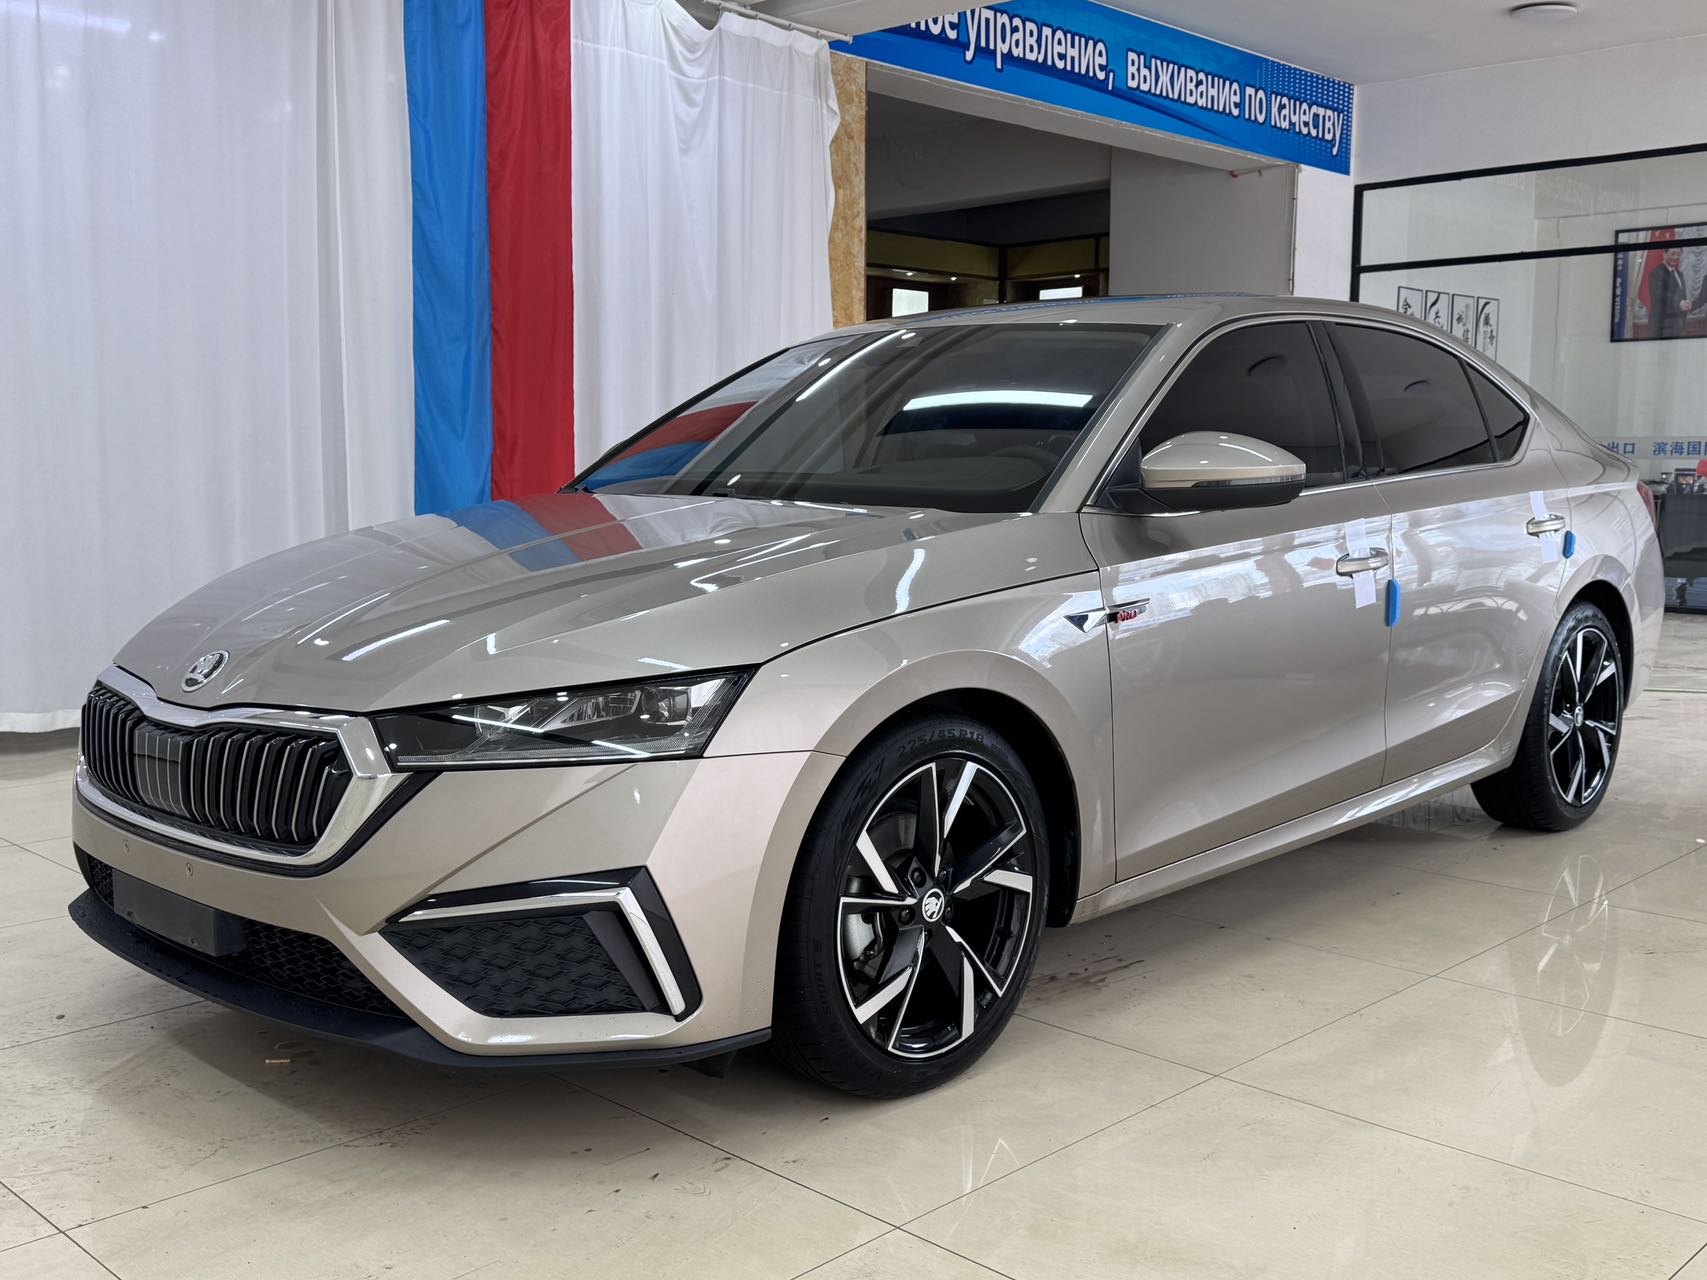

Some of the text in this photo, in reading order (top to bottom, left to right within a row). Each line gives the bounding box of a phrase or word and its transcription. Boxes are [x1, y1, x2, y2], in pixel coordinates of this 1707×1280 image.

[965, 7, 1114, 91] управление,
[1127, 51, 1240, 117] выживание
[1245, 86, 1267, 123] по
[1271, 93, 1343, 155] качеству
[1653, 441, 1707, 456] 滨海国
